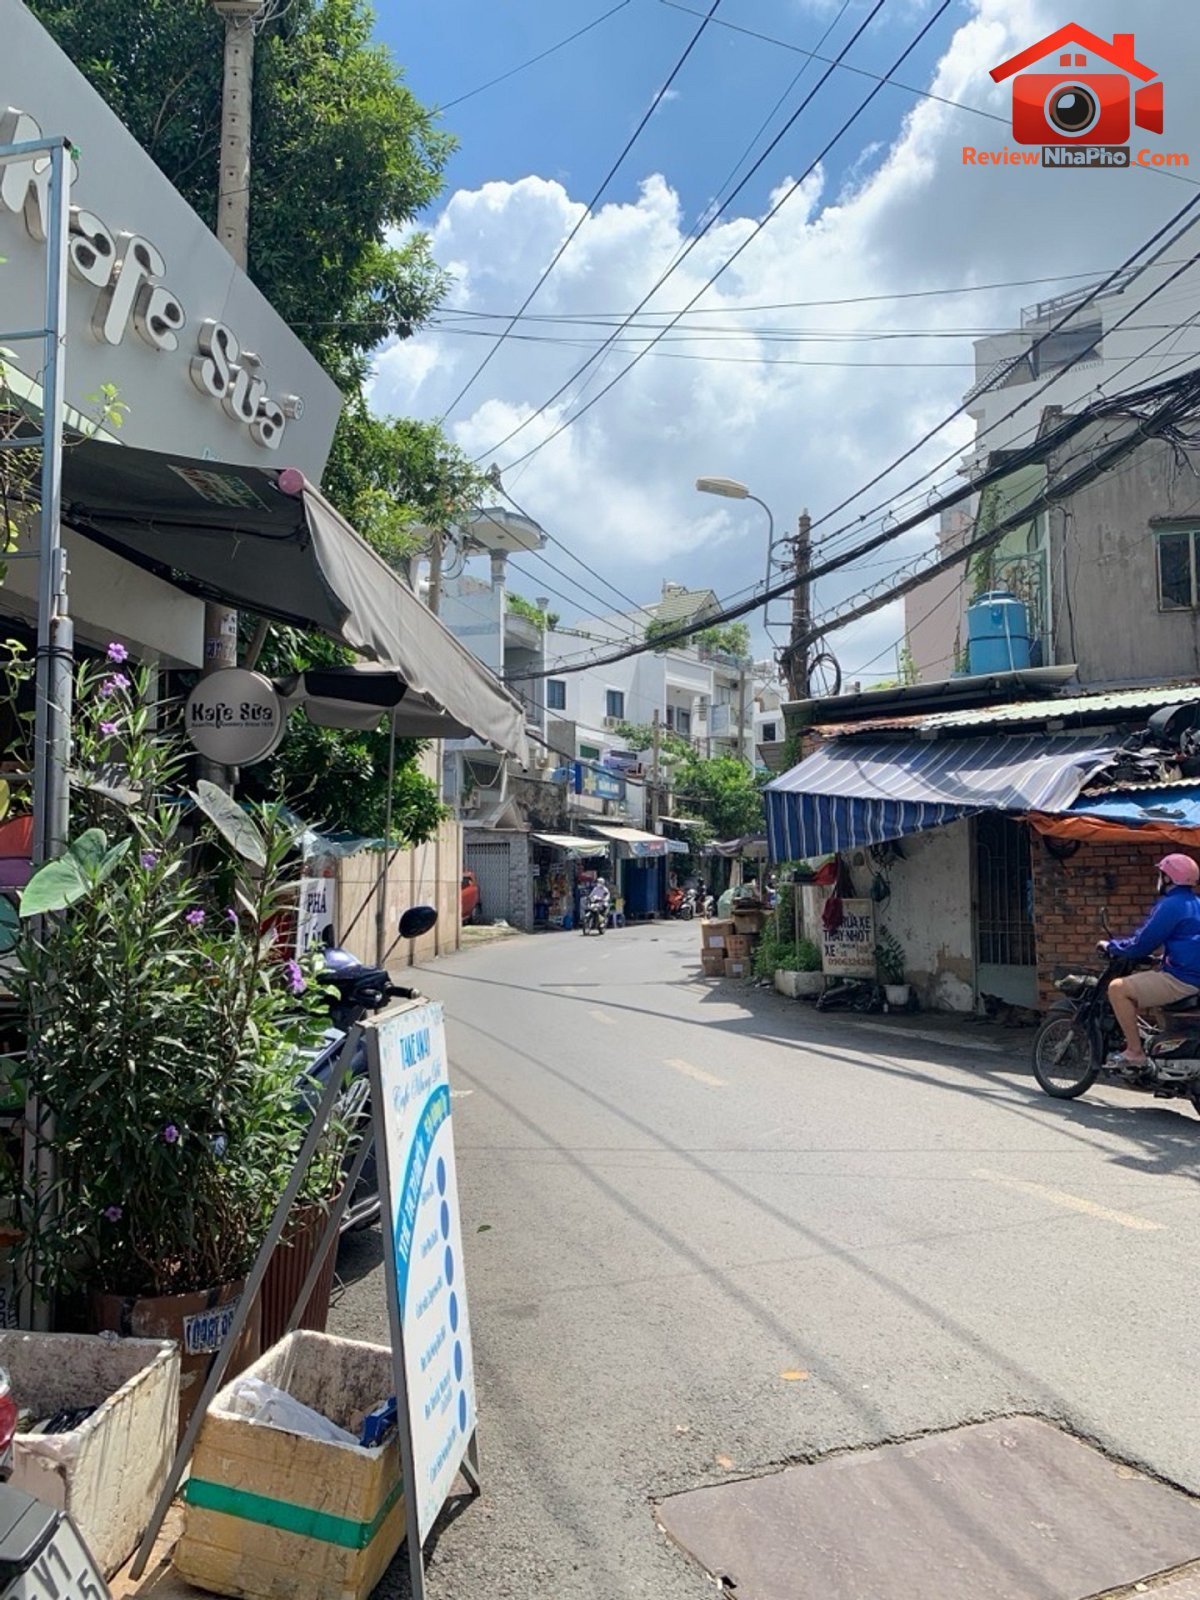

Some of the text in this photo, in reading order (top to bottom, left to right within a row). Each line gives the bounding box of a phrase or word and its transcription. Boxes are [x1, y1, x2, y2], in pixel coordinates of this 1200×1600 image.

[192, 702, 273, 729] Kafe Sữa
[307, 887, 327, 913] PHÁ
